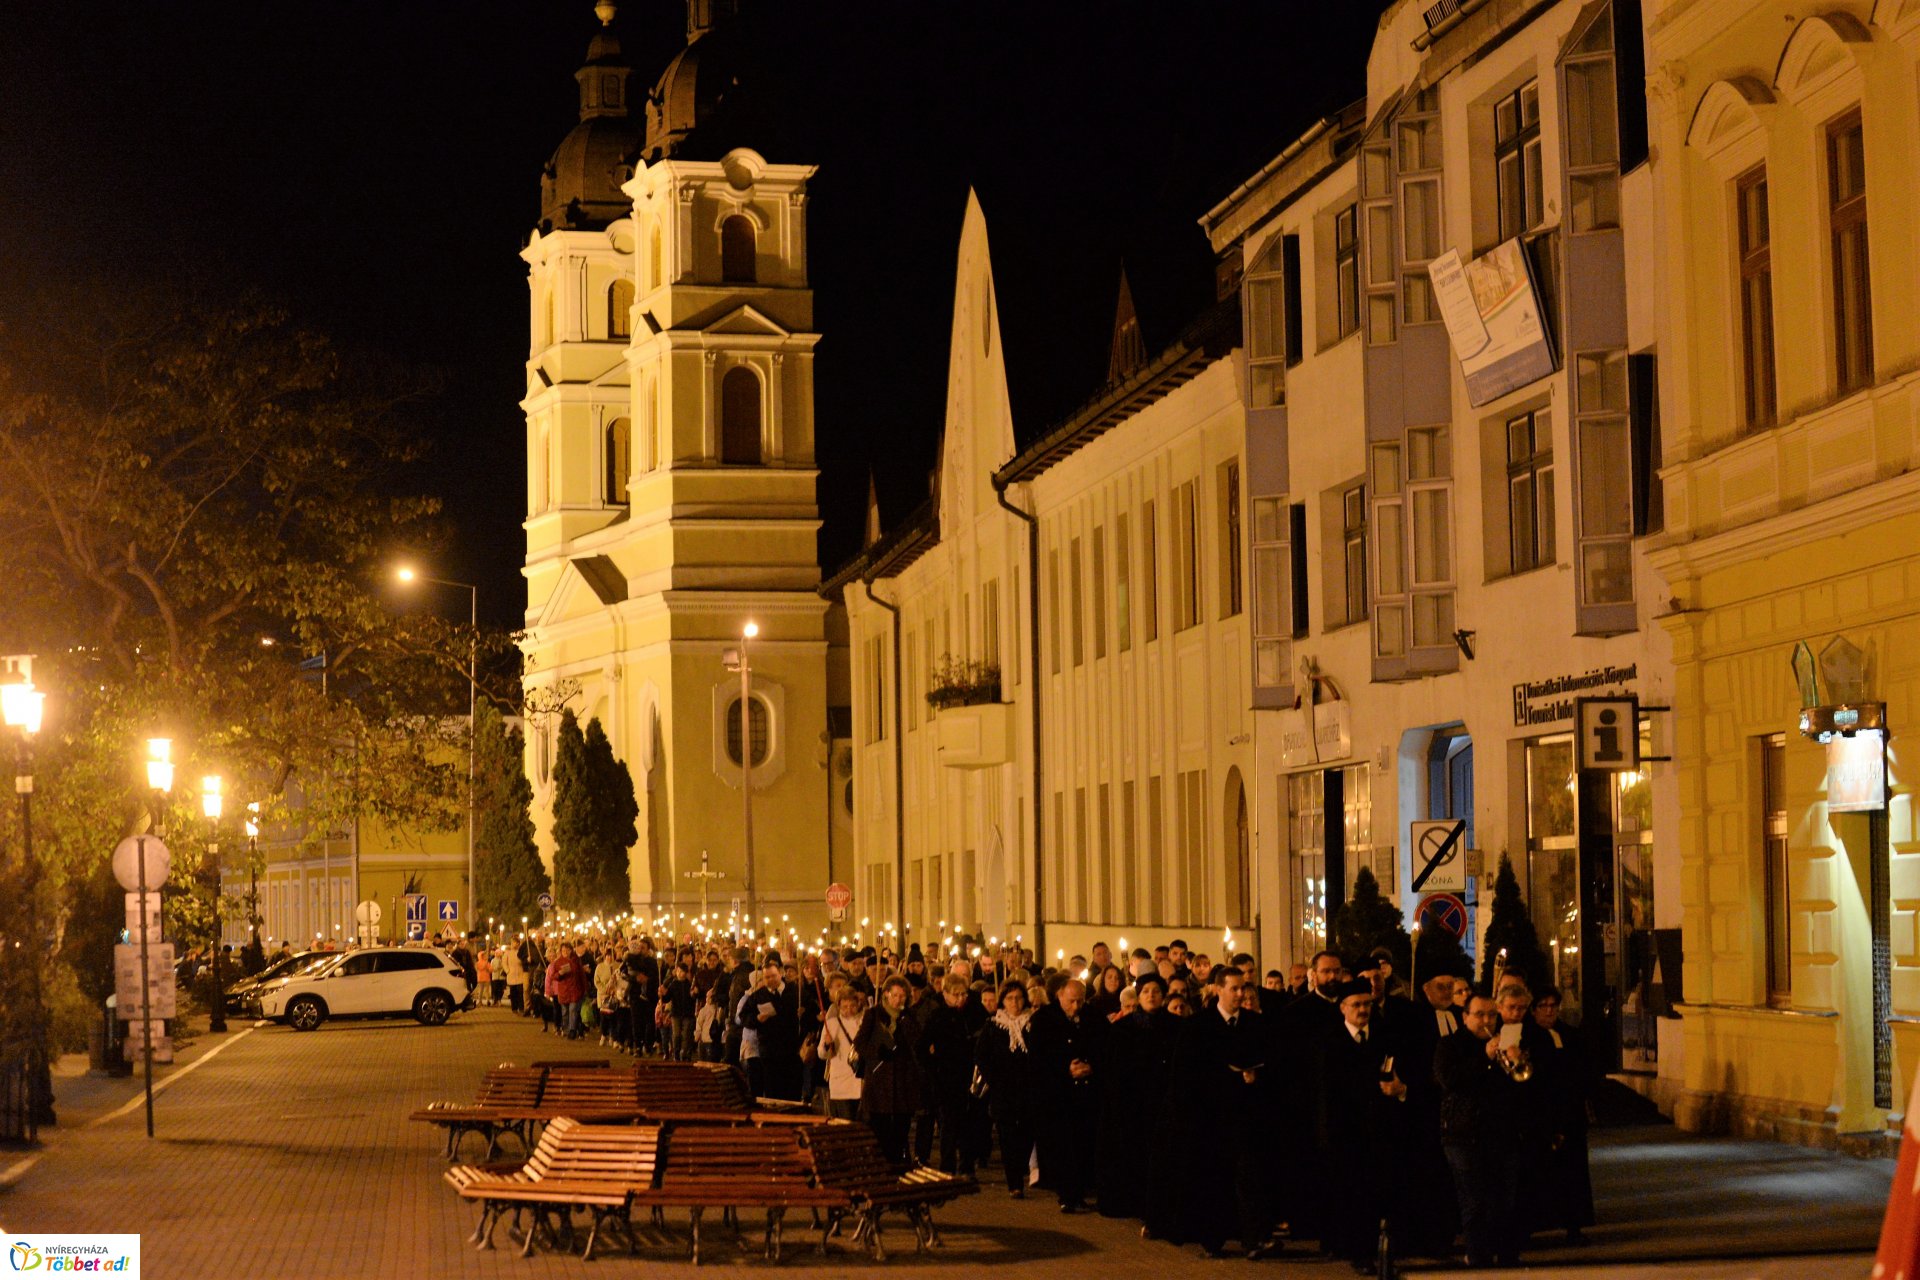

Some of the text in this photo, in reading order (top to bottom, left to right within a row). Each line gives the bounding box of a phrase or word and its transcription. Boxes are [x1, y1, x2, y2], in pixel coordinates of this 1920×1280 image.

[1604, 662, 1637, 686] Központ
[1528, 703, 1556, 724] Tourist
[828, 891, 849, 901] STOP
